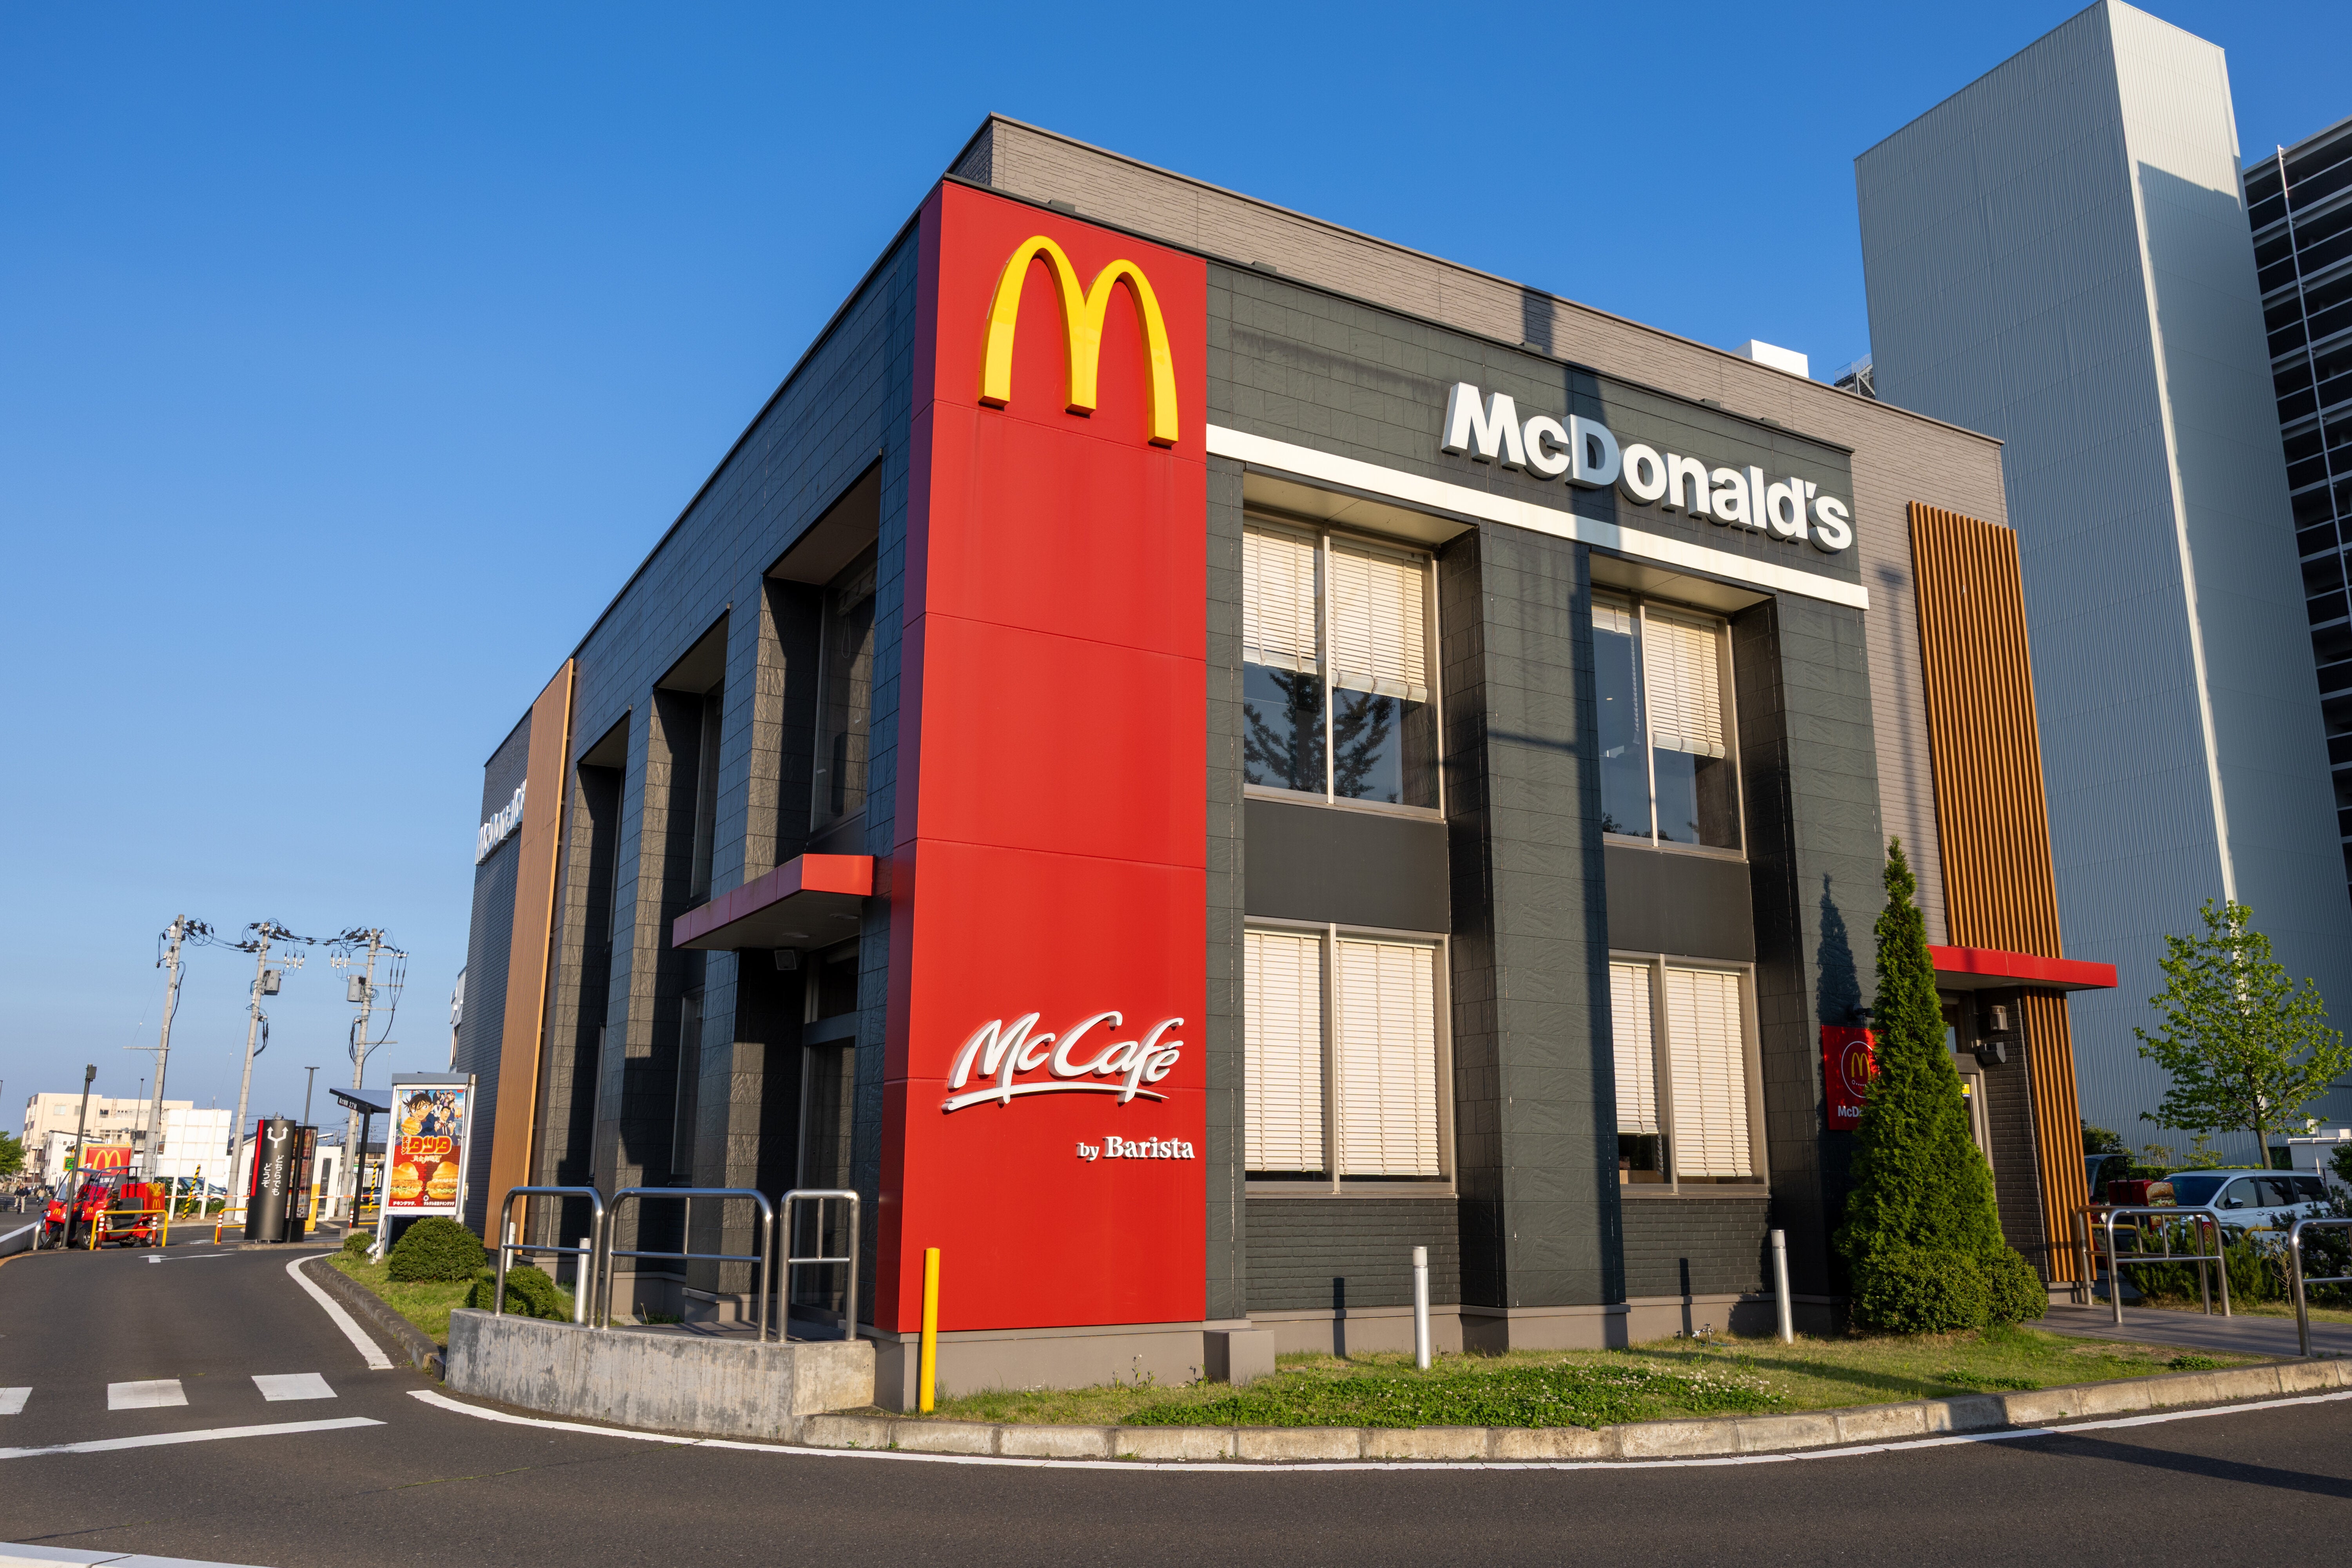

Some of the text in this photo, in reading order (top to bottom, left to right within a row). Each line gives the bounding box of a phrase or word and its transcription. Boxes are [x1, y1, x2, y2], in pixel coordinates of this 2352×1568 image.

[1441, 381, 1852, 552] McDonald's
[942, 1010, 1184, 1111] McCafé
[407, 1136, 452, 1154] タツタ
[1076, 1136, 1196, 1162] by Barista
[261, 1163, 272, 1188] どうぞ
[272, 1155, 284, 1196] どちらでも
